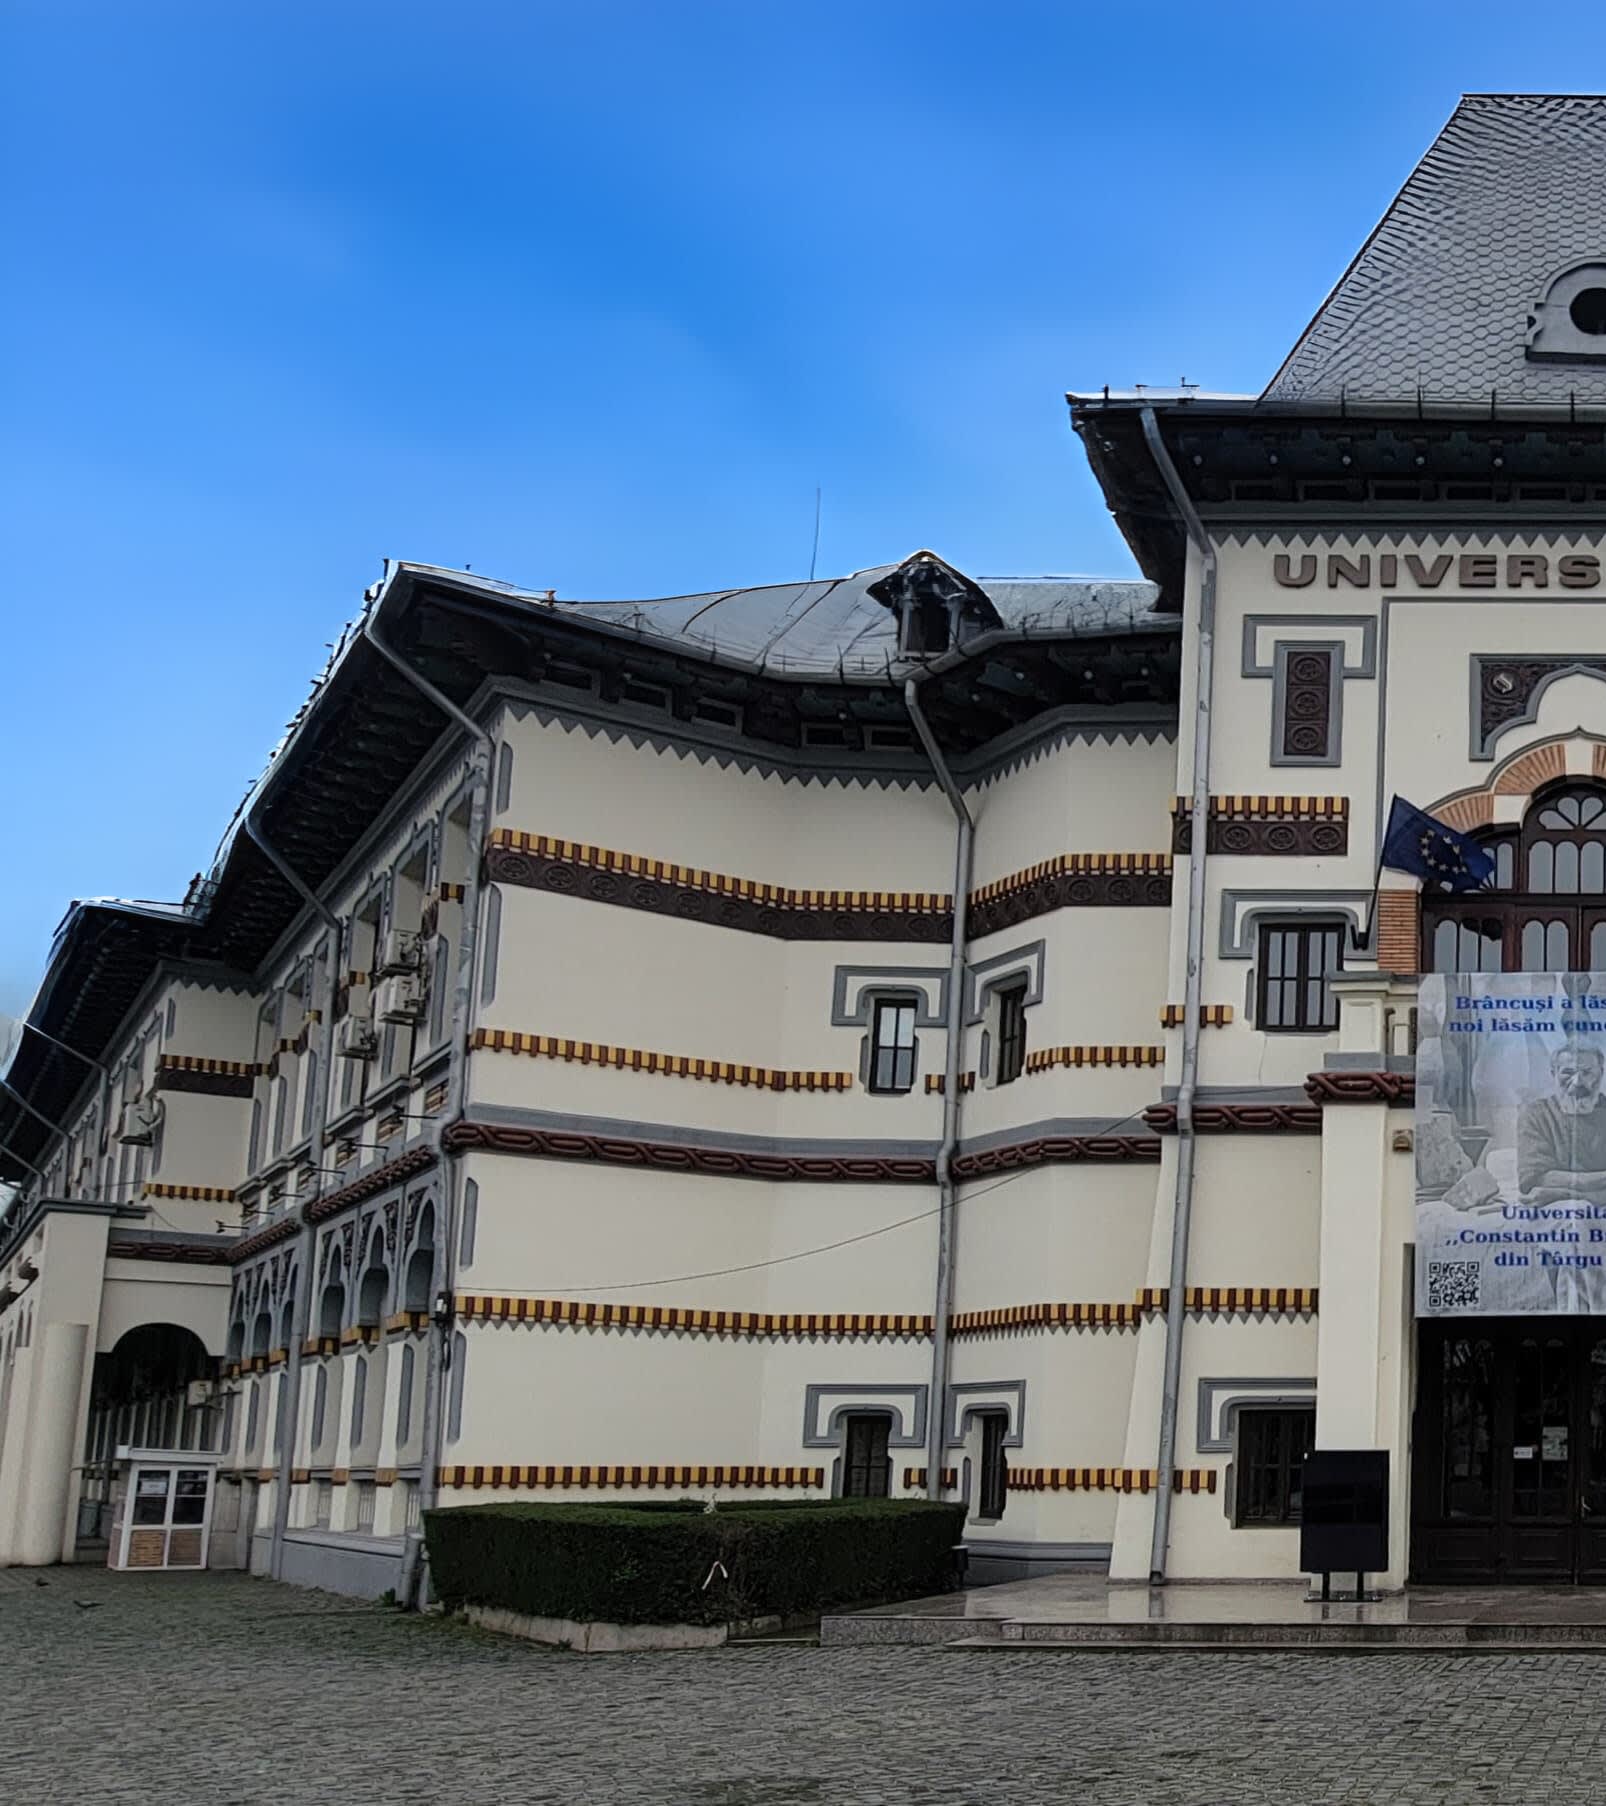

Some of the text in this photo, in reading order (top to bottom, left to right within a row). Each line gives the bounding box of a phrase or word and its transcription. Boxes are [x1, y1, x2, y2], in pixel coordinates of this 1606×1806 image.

[1560, 999, 1574, 1010] a
[1449, 1019, 1483, 1033] noi
[1490, 1018, 1556, 1032] lăsăm
[1494, 1251, 1530, 1267] din
[1536, 1250, 1603, 1270] Târgu
